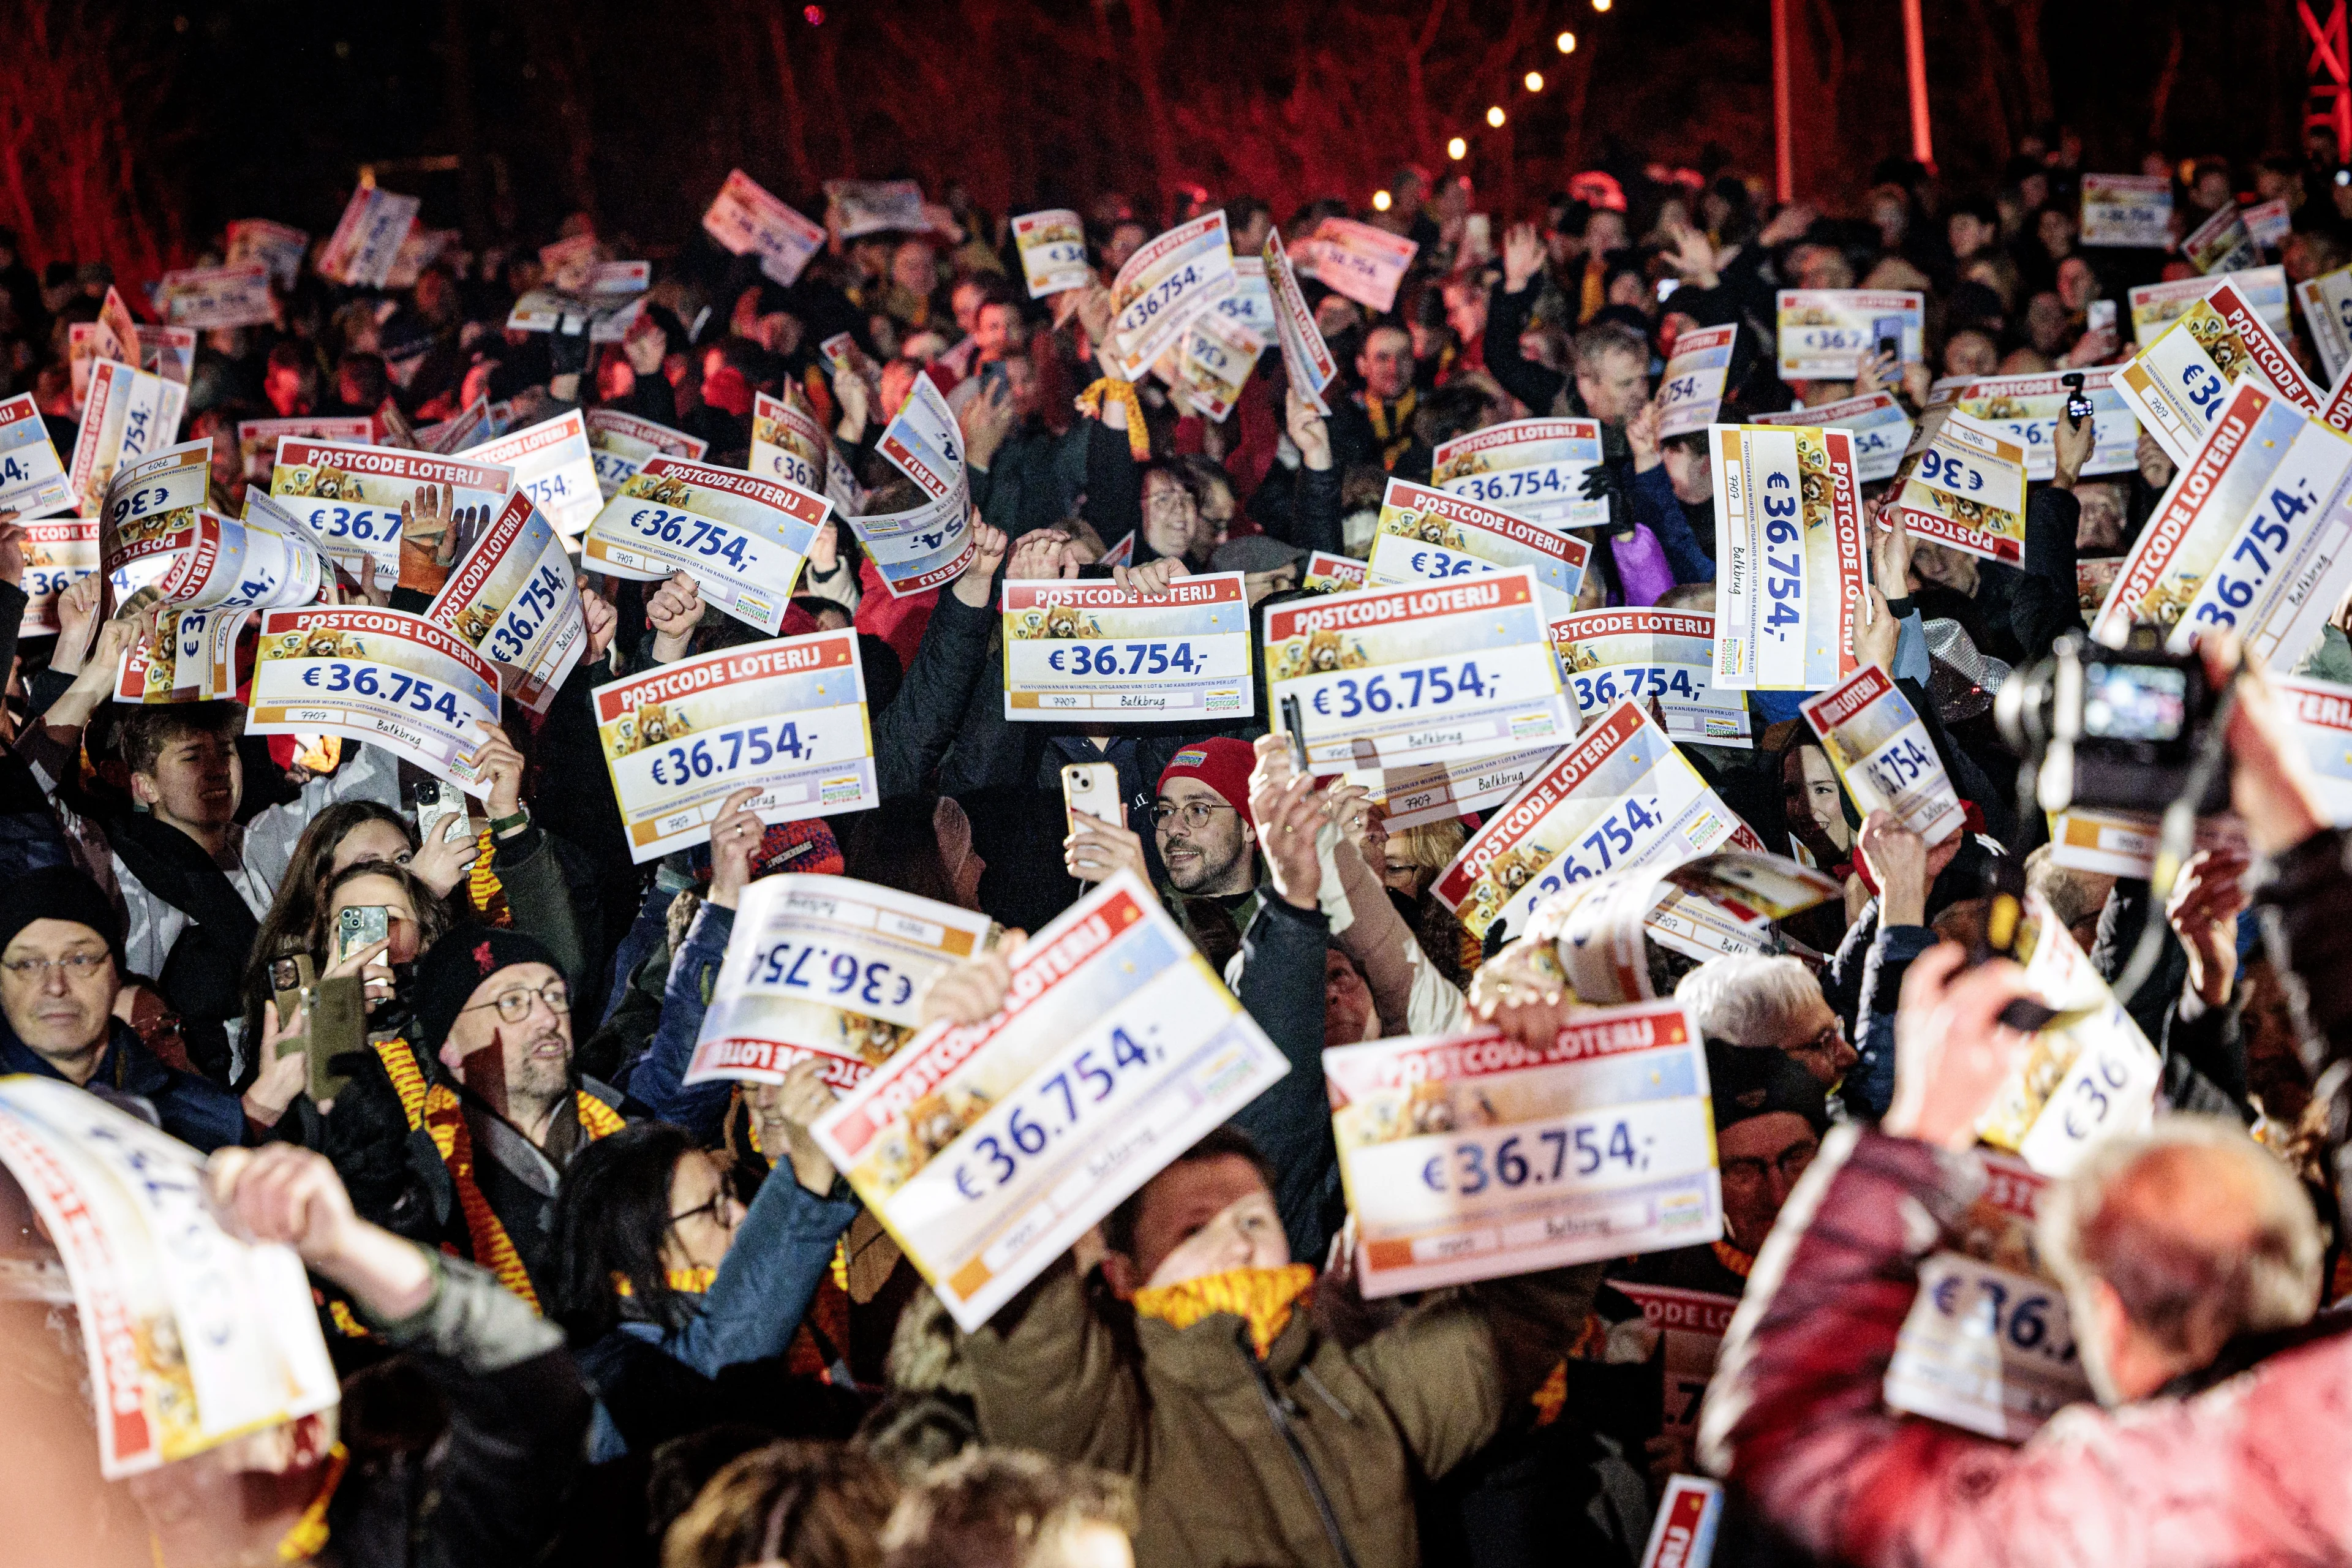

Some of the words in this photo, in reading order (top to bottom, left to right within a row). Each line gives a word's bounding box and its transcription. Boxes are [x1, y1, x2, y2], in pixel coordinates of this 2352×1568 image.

[2227, 307, 2305, 399] POSTCODE
[1978, 382, 2053, 398] POSTCODE
[522, 424, 568, 450] LOTERIJ
[1517, 424, 1578, 441] LOTERIJ
[307, 448, 406, 476] POSTCODE
[409, 460, 484, 486] LOTERIJ
[661, 464, 737, 495] POSTCODE
[733, 476, 801, 512] LOTERIJ
[1728, 475, 1740, 500] 7707
[1413, 493, 1504, 532] POSTCODE
[1507, 519, 1567, 555] LOTERIJ
[1832, 462, 1860, 570] POSTCODE
[2117, 495, 2194, 619] POSTCODE
[2187, 416, 2248, 502] LOTERIJ
[1905, 516, 1994, 551] POSTCOD
[104, 534, 176, 570] POSTCOD
[616, 552, 634, 565] 7707
[434, 555, 489, 628] POSTCODE
[488, 508, 522, 556] LOTERIJ
[632, 541, 653, 553] WIJKPRIJS,
[654, 548, 677, 560] UITGAANDE
[713, 570, 753, 592] KANJERPUNTEN
[753, 586, 764, 595] PER
[1332, 563, 1366, 585] POST
[1728, 547, 1747, 595] Balkbrug
[736, 603, 769, 620] POSTCODE
[738, 609, 764, 623] LOTERIJ
[741, 600, 766, 614] NATIONALE
[1294, 595, 1408, 633] POSTCODE
[1408, 582, 1501, 614] LOTERIJ
[1638, 616, 1711, 635] LOTERIJ
[296, 612, 412, 637] POSTCODE
[415, 624, 483, 673] LOTERIJ
[621, 662, 725, 712] POSTCODE
[729, 646, 821, 679] LOTERIJ
[301, 710, 328, 720] 7707
[1120, 695, 1166, 711] Balkbrug
[1674, 706, 1714, 714] KANJERPUNTEN
[355, 703, 389, 715] UITGAANDE
[432, 727, 471, 750] KANJERPUNTEN
[376, 718, 422, 750] Balkbrug
[1706, 728, 1738, 736] POSTCODE
[1451, 764, 1484, 777] UITGAANDE
[1478, 771, 1525, 791] Balkbrug
[1404, 794, 1431, 809] 7707
[1463, 783, 1556, 880] POSTCODE
[1552, 726, 1621, 793] LOTERIJ
[1692, 817, 1721, 846] POSTCODE
